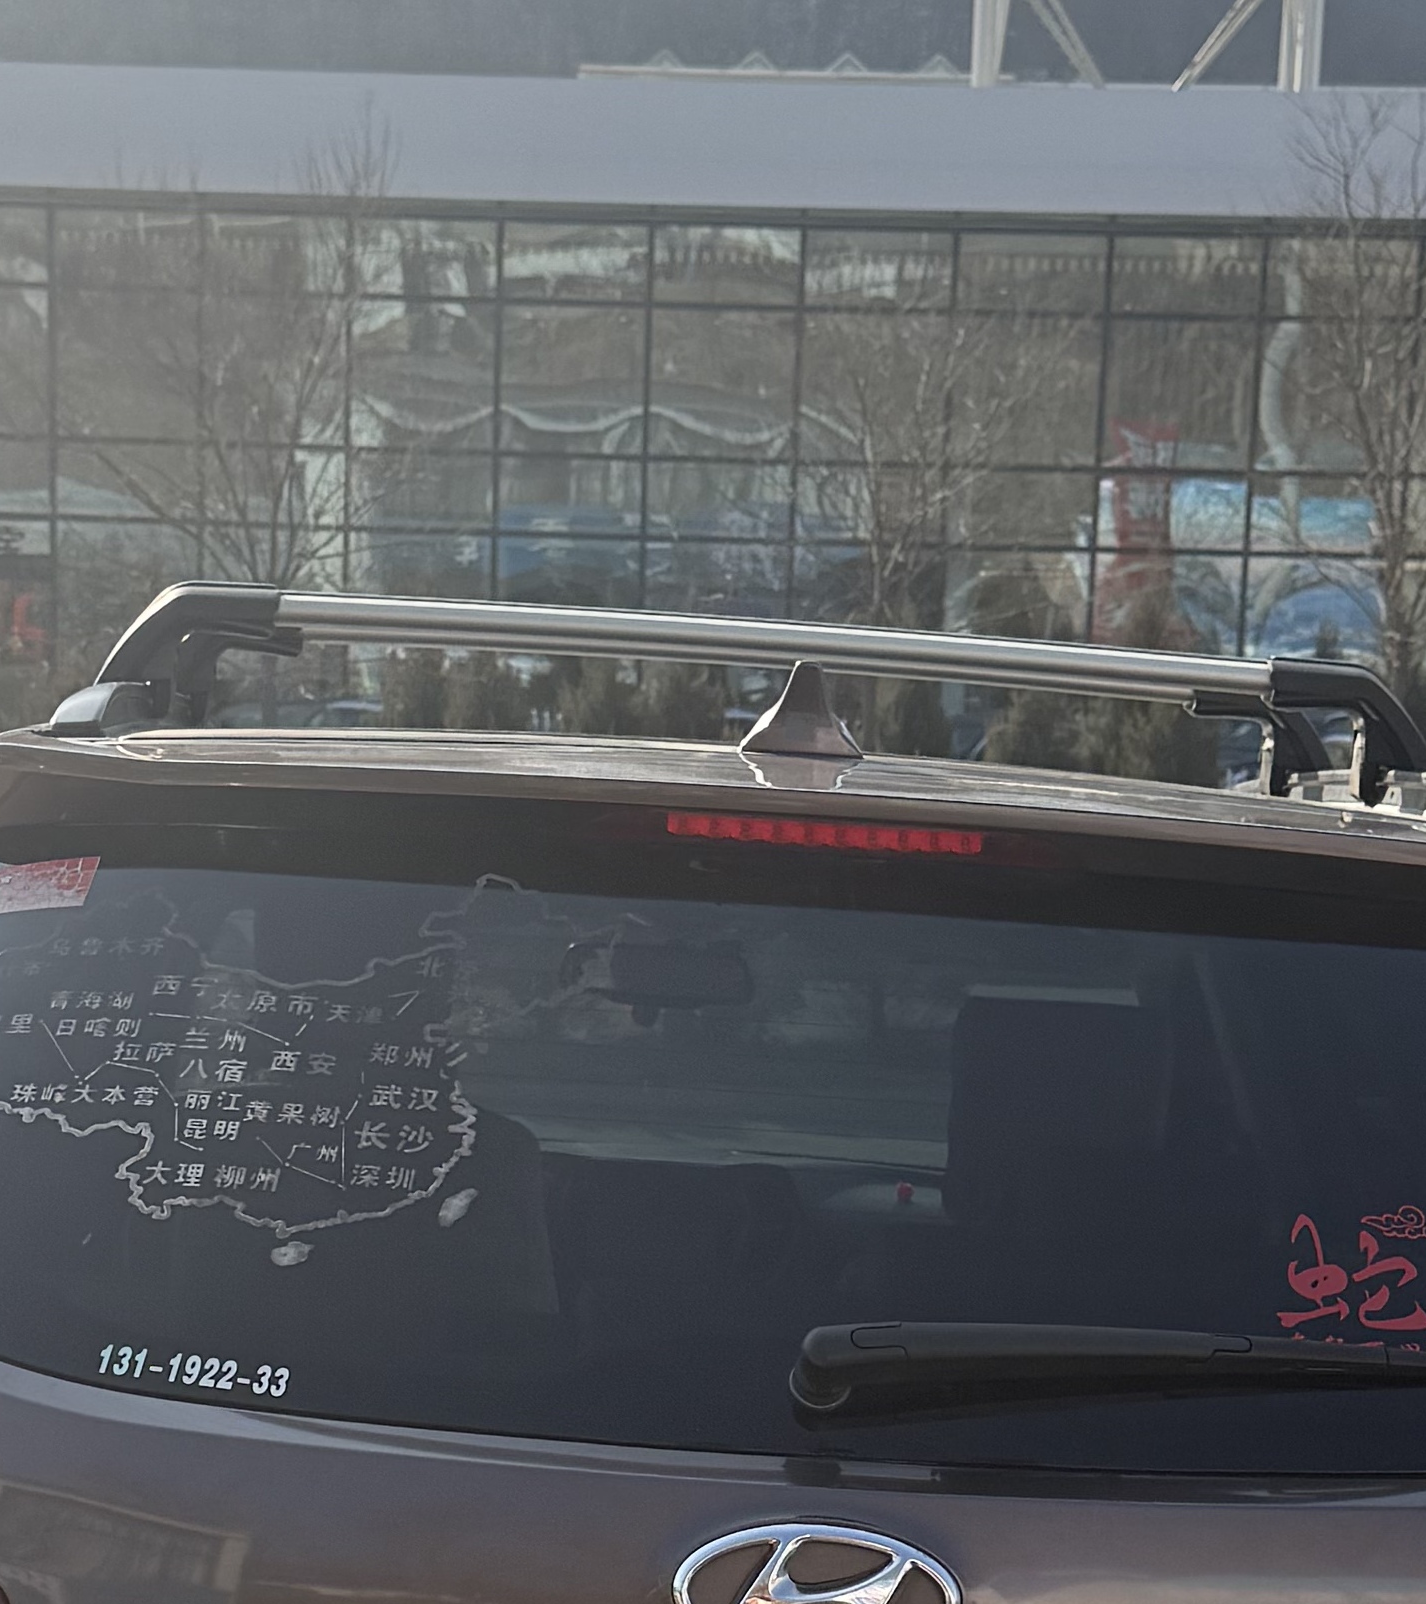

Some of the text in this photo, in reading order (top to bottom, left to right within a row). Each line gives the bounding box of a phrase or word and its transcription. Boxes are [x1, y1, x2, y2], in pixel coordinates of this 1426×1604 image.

[152, 974, 218, 998] 西宁
[49, 990, 135, 1011] 青海湖
[113, 1041, 176, 1063] 拉萨
[178, 1026, 247, 1052] 兰州
[270, 1050, 337, 1076] 西安
[369, 1042, 435, 1069] 郑州
[179, 1058, 248, 1082] 八宿
[184, 1089, 243, 1111] 丽江
[368, 1084, 440, 1112] 武汉
[242, 1099, 341, 1129] 黄果树
[183, 1118, 241, 1141] 昆明
[354, 1120, 435, 1153] 长沙
[286, 1141, 340, 1163] 广州
[142, 1160, 205, 1187] 大理
[213, 1164, 282, 1193] 柳州
[349, 1163, 417, 1191] 深圳
[98, 1344, 290, 1398] 131-1922-33
